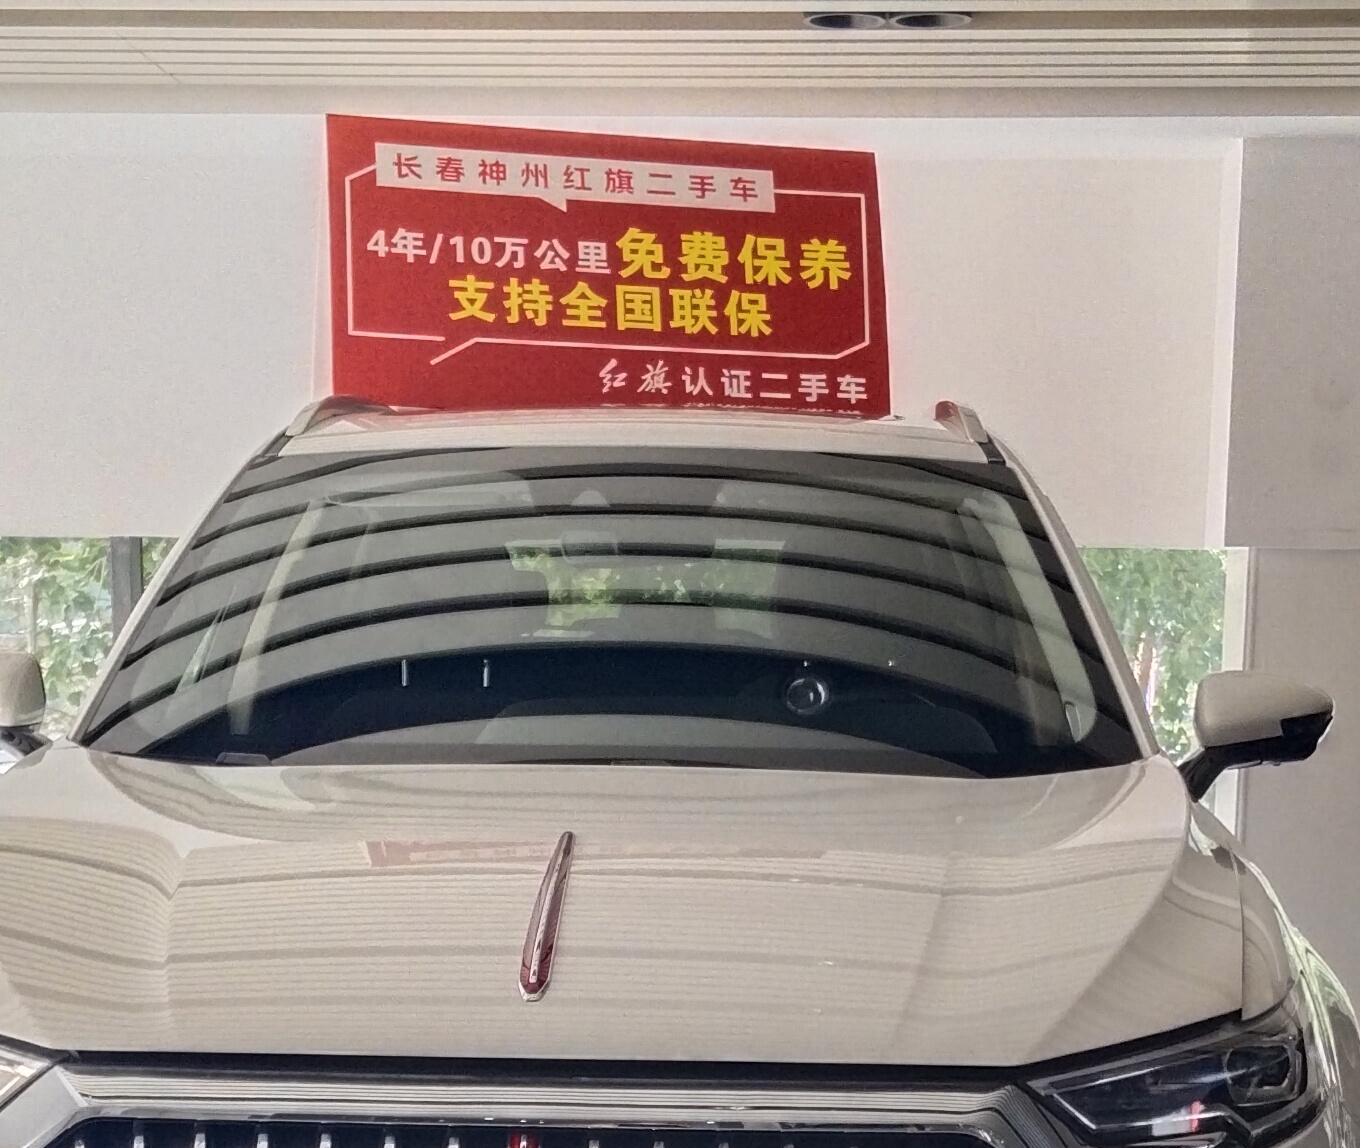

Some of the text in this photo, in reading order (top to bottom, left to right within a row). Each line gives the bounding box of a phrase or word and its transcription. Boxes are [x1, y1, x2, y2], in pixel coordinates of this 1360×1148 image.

[392, 153, 759, 202] 长春神州红旗二手车
[366, 228, 852, 289] 4年/10万公里免费保养
[448, 275, 772, 337] 支持全国联保
[599, 358, 868, 404] 红旗认证二手车
